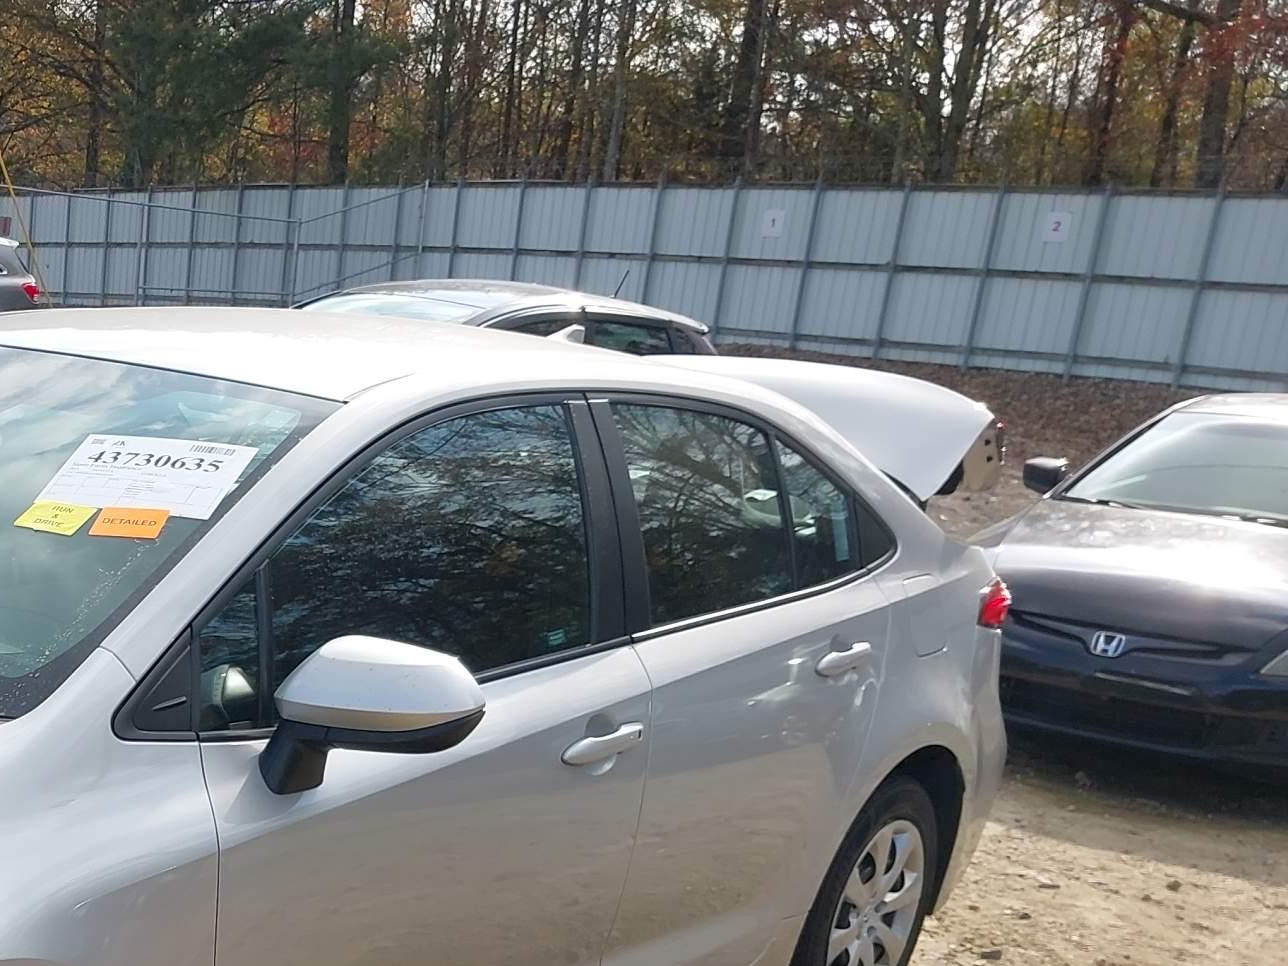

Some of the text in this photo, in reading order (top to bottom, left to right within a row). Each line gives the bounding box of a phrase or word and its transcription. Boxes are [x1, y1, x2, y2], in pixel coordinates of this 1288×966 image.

[1051, 220, 1062, 233] 2
[87, 449, 225, 473] 43730635
[51, 504, 74, 514] RUN
[33, 517, 65, 529] DRIVE
[101, 516, 157, 527] DETAILED
